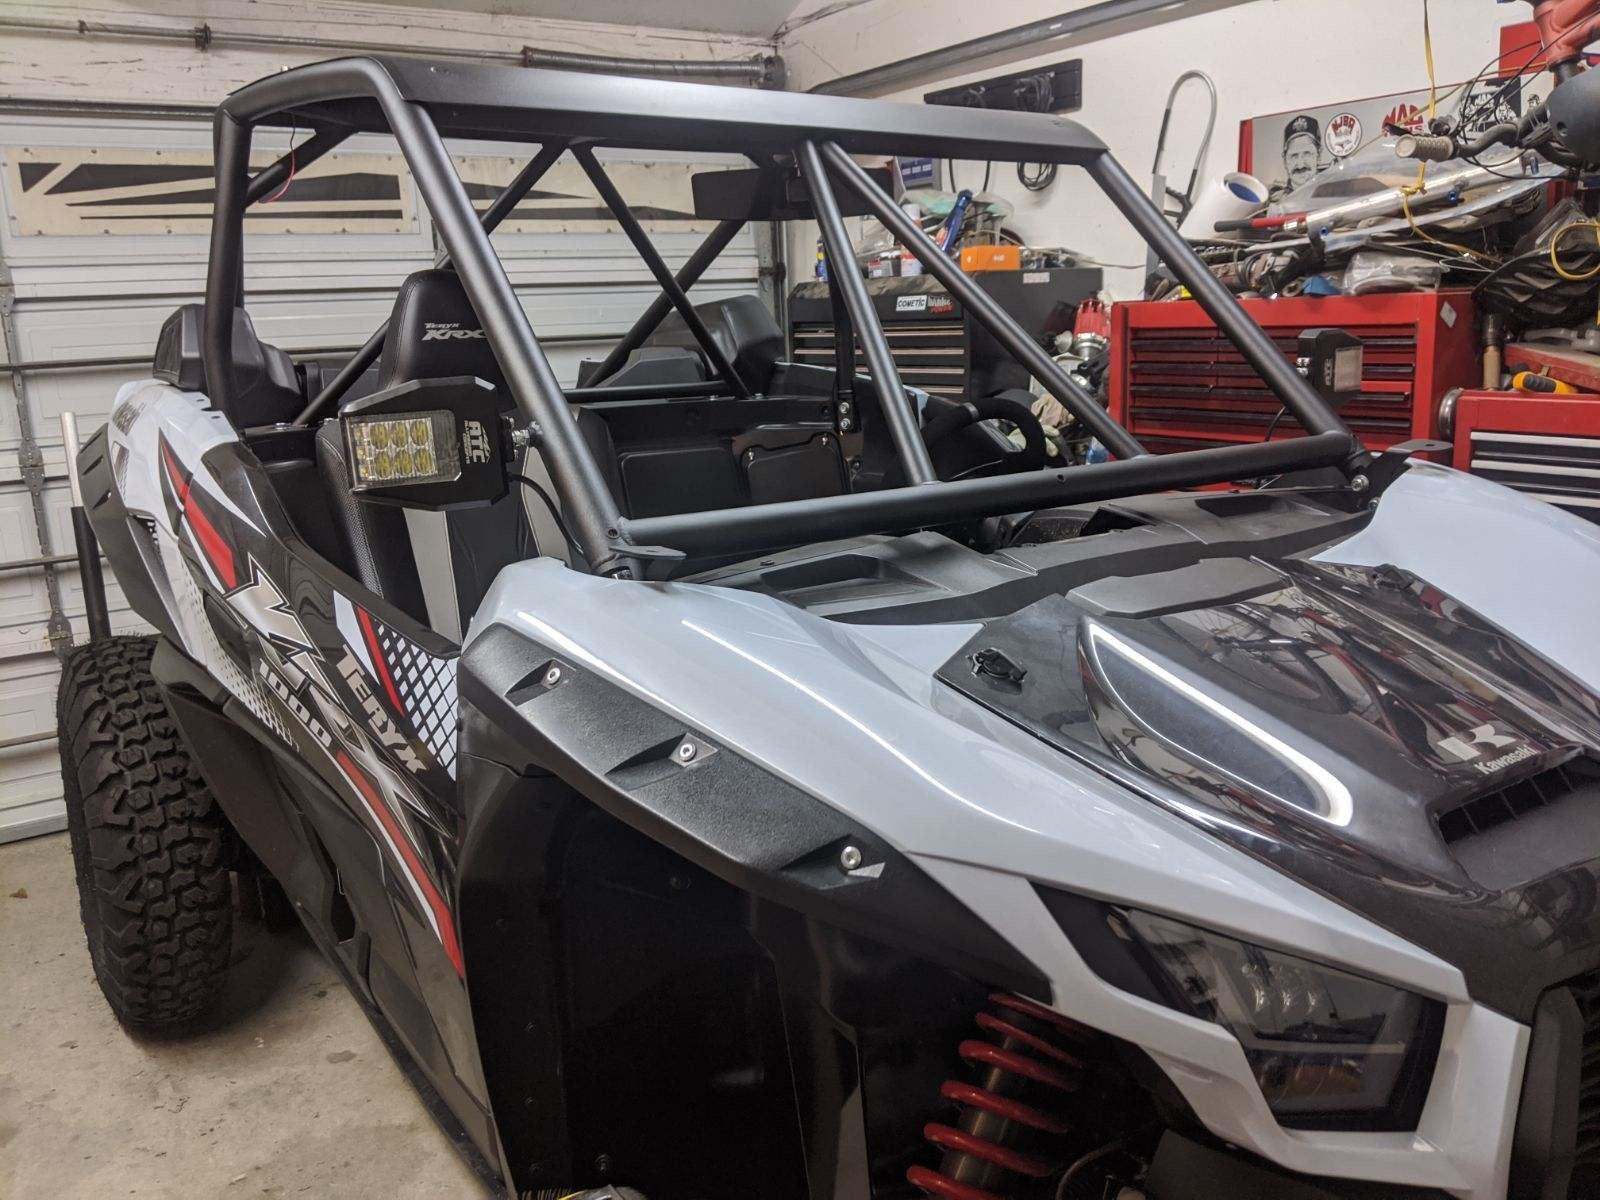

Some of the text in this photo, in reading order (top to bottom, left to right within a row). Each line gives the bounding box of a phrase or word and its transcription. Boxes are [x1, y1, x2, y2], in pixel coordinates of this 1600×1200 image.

[258, 657, 332, 748] 1000
[336, 643, 428, 774] TERYX
[1474, 743, 1541, 775] Kawasaki
